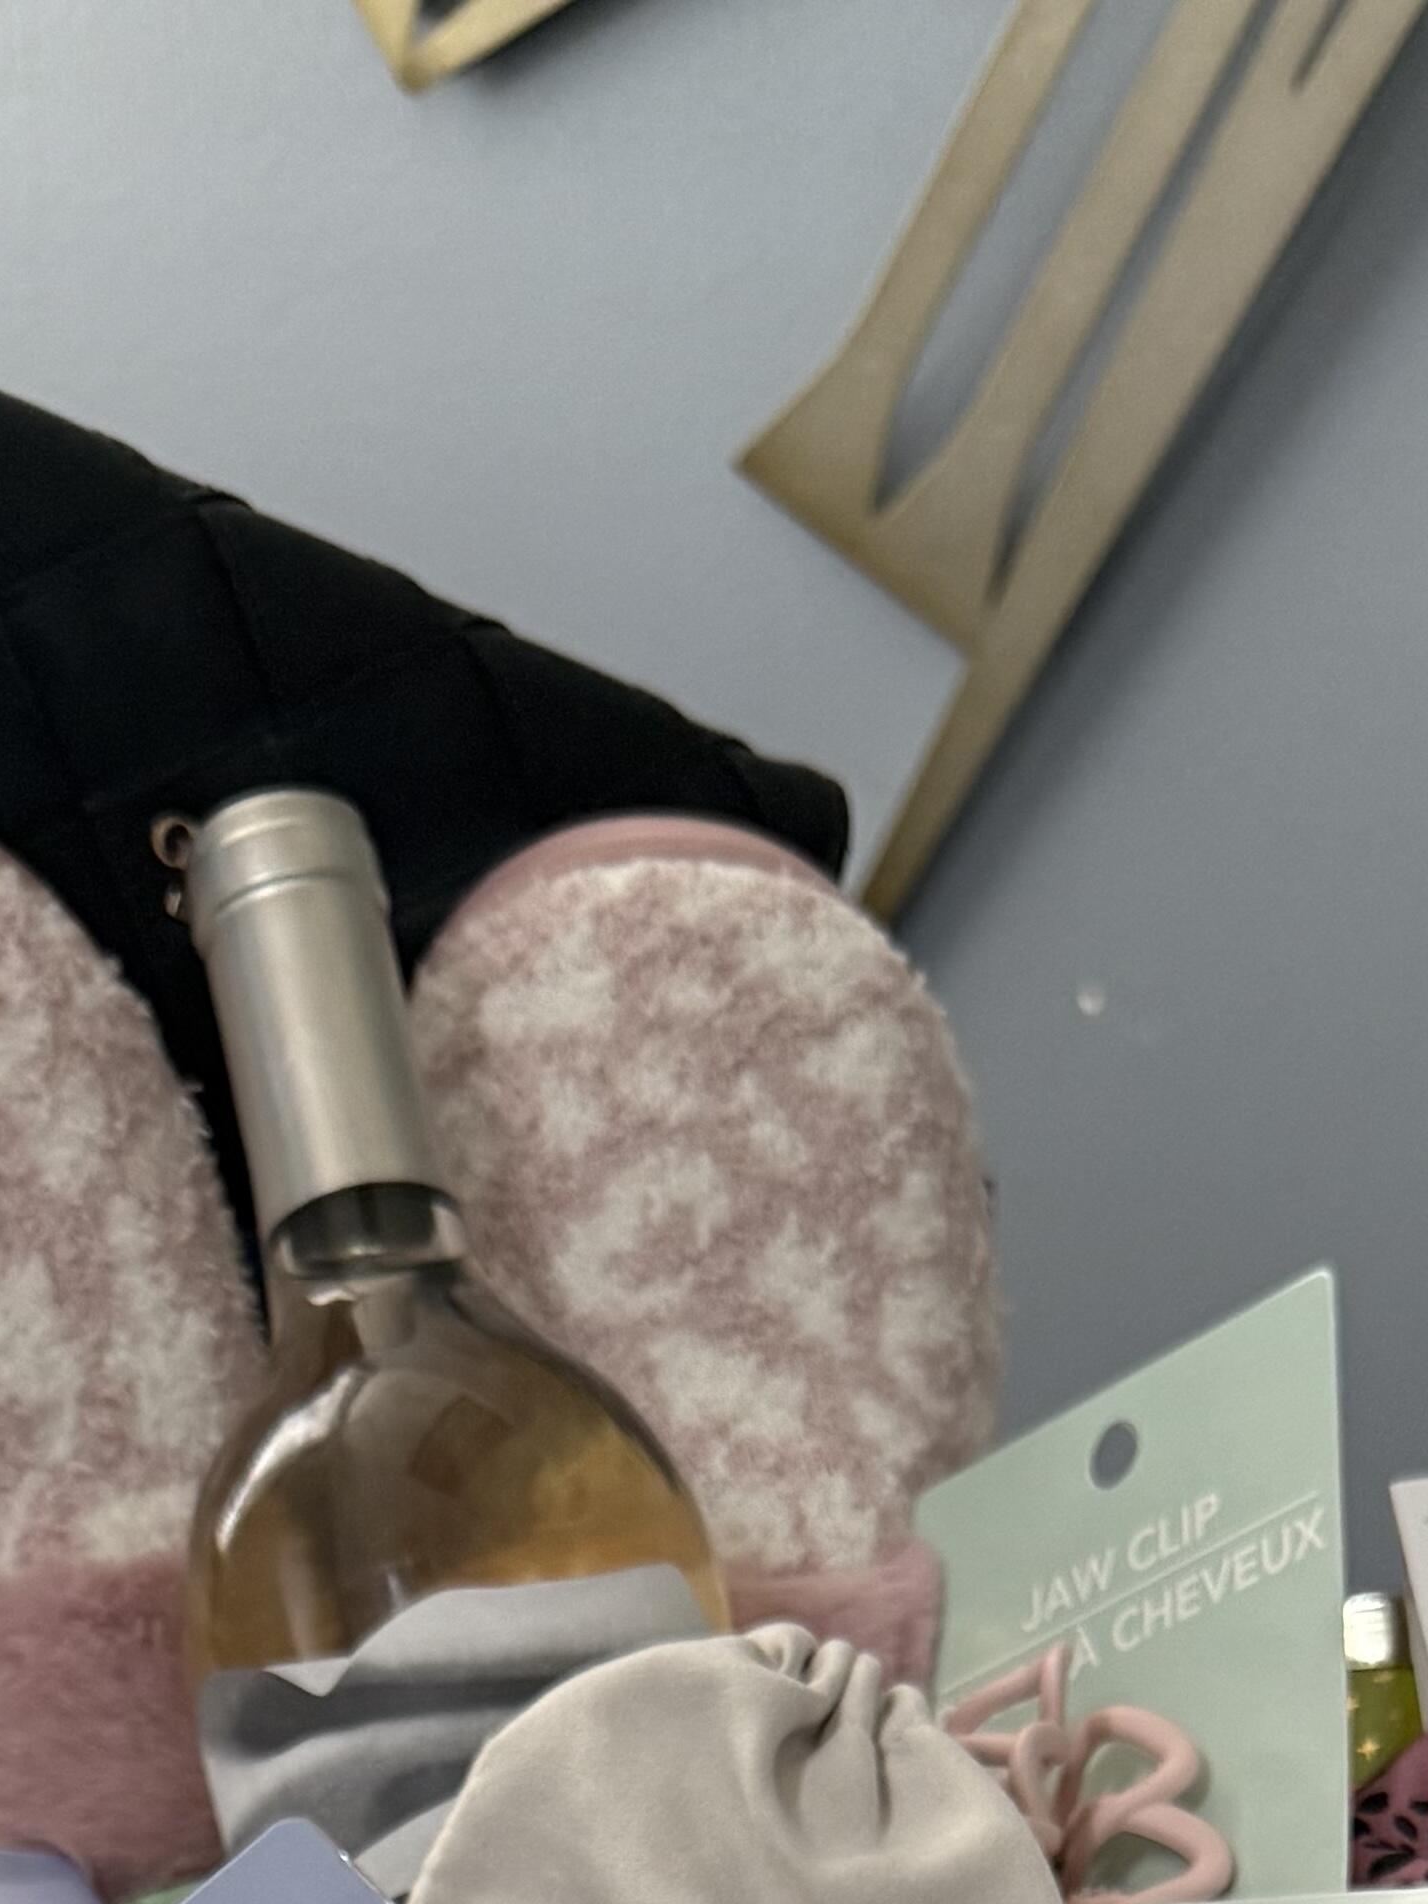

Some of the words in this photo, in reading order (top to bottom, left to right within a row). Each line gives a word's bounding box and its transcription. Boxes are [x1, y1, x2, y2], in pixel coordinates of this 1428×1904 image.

[1020, 1547, 1113, 1635] JAW
[1127, 1493, 1221, 1570] CLIP
[1113, 1507, 1328, 1650] CHEVEUX
